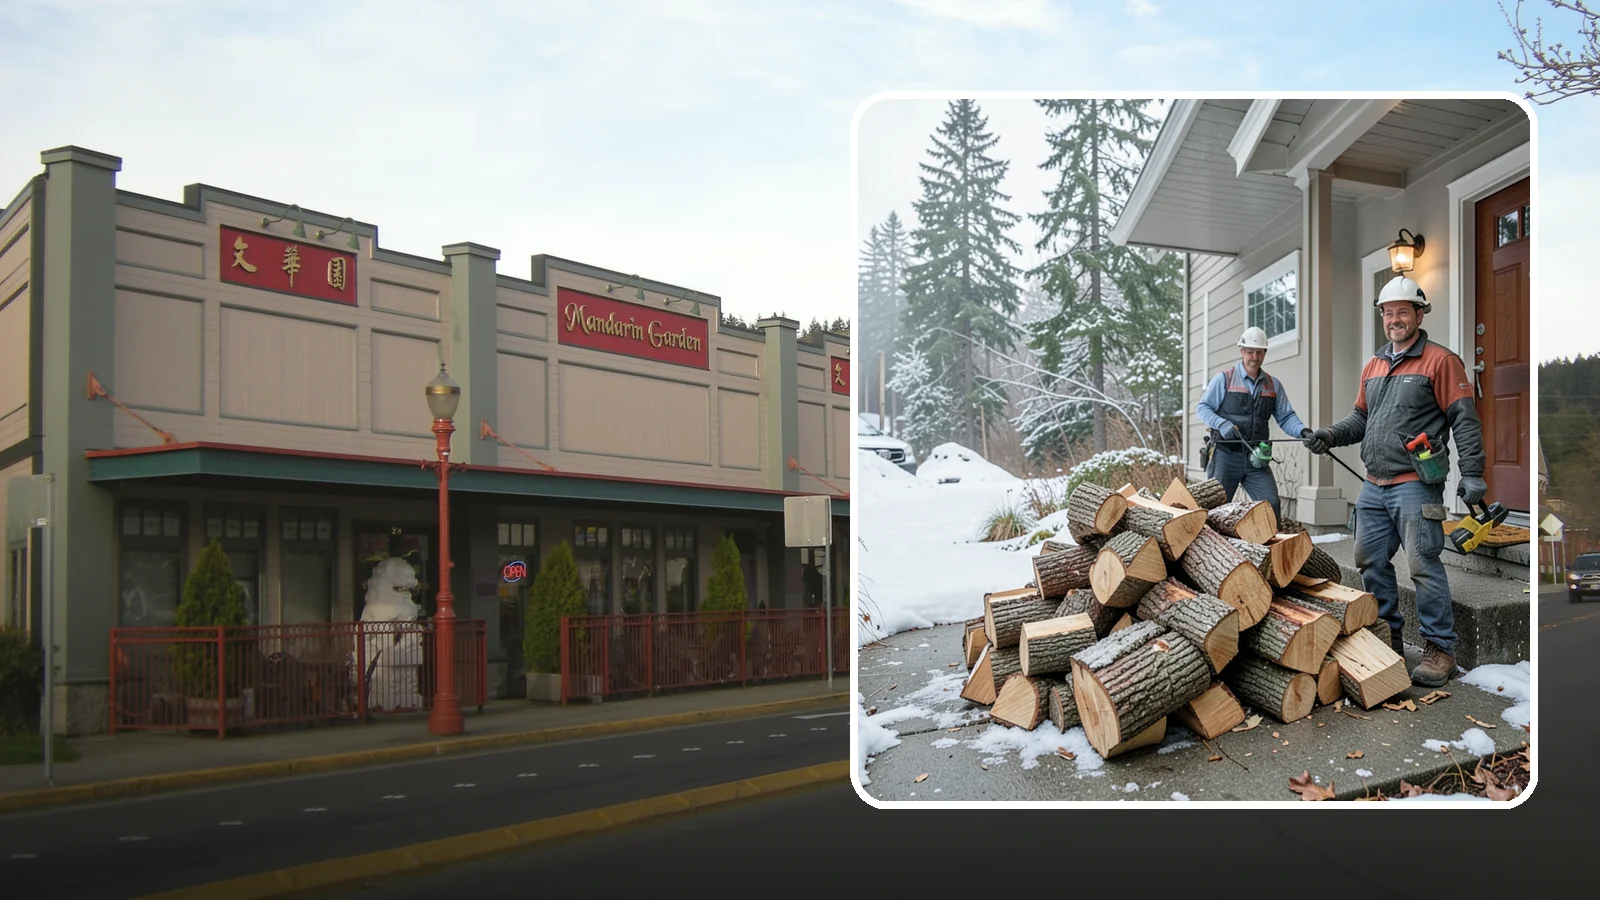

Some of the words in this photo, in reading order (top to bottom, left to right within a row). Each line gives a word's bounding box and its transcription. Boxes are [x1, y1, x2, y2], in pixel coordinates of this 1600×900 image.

[231, 236, 346, 291] 文華園
[564, 302, 644, 341] Mandarin
[648, 320, 702, 352] Garden
[503, 565, 527, 578] OPEN
